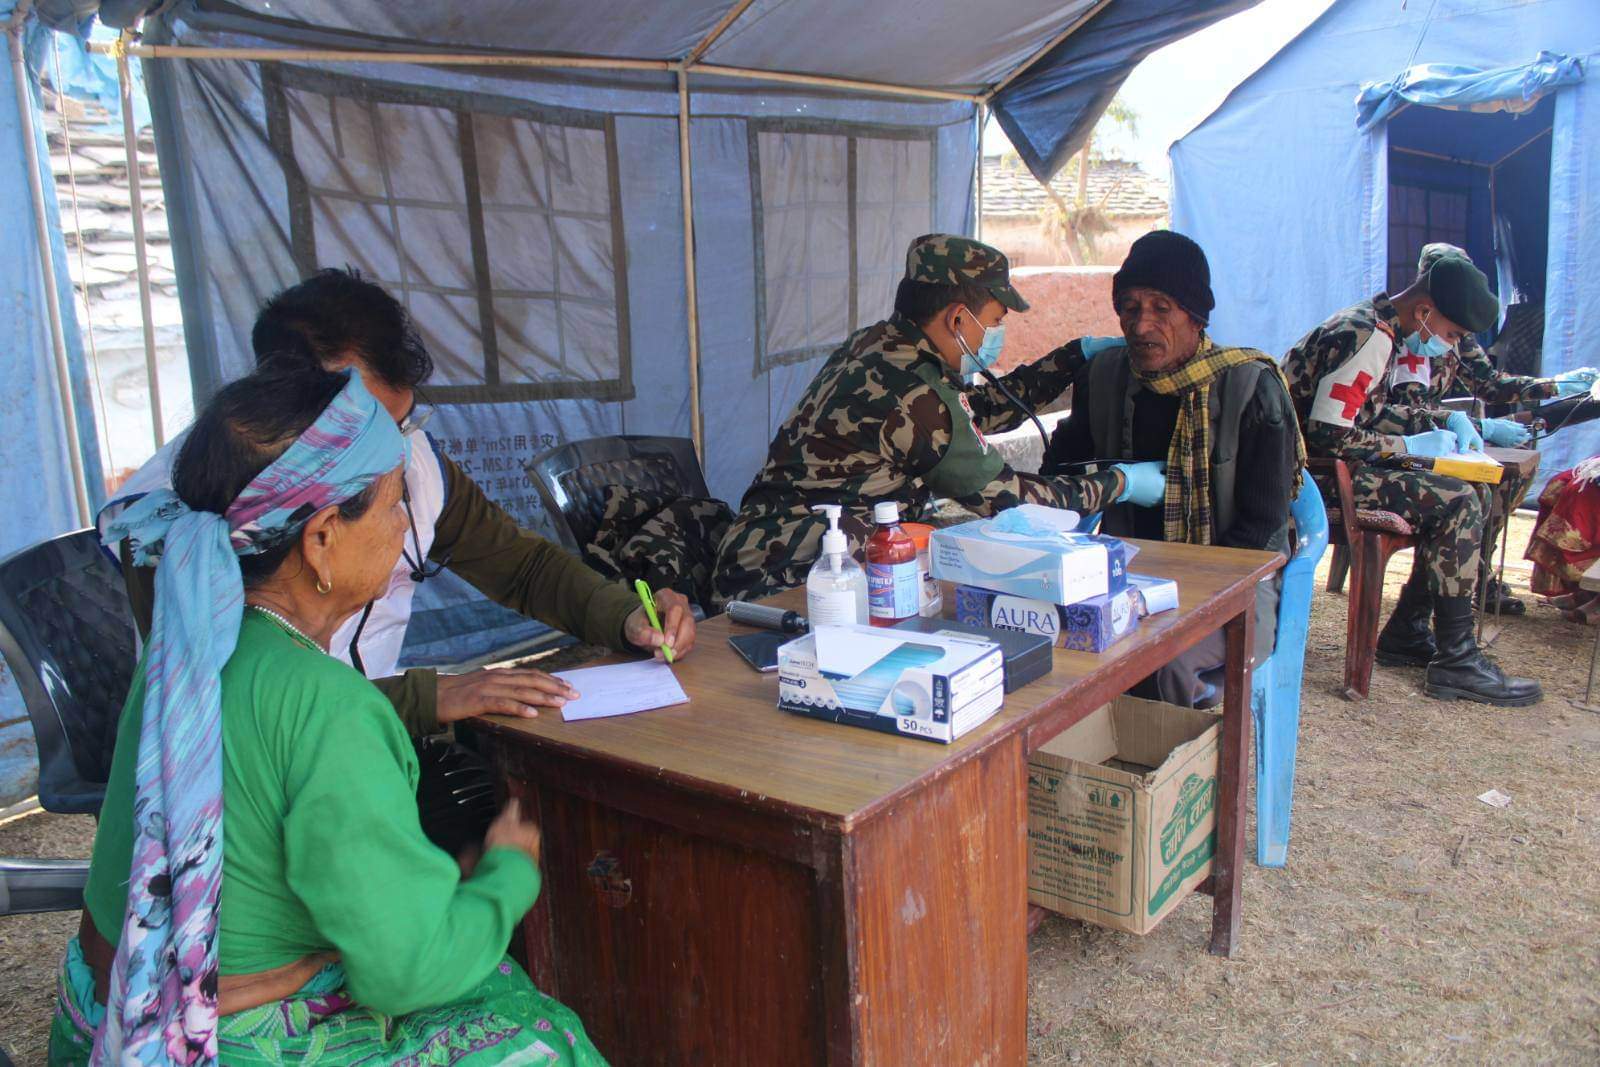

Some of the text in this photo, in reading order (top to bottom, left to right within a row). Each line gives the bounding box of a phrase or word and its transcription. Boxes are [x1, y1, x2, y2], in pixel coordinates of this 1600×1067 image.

[995, 606, 1056, 635] AURA
[903, 719, 933, 735] 50 PCS
